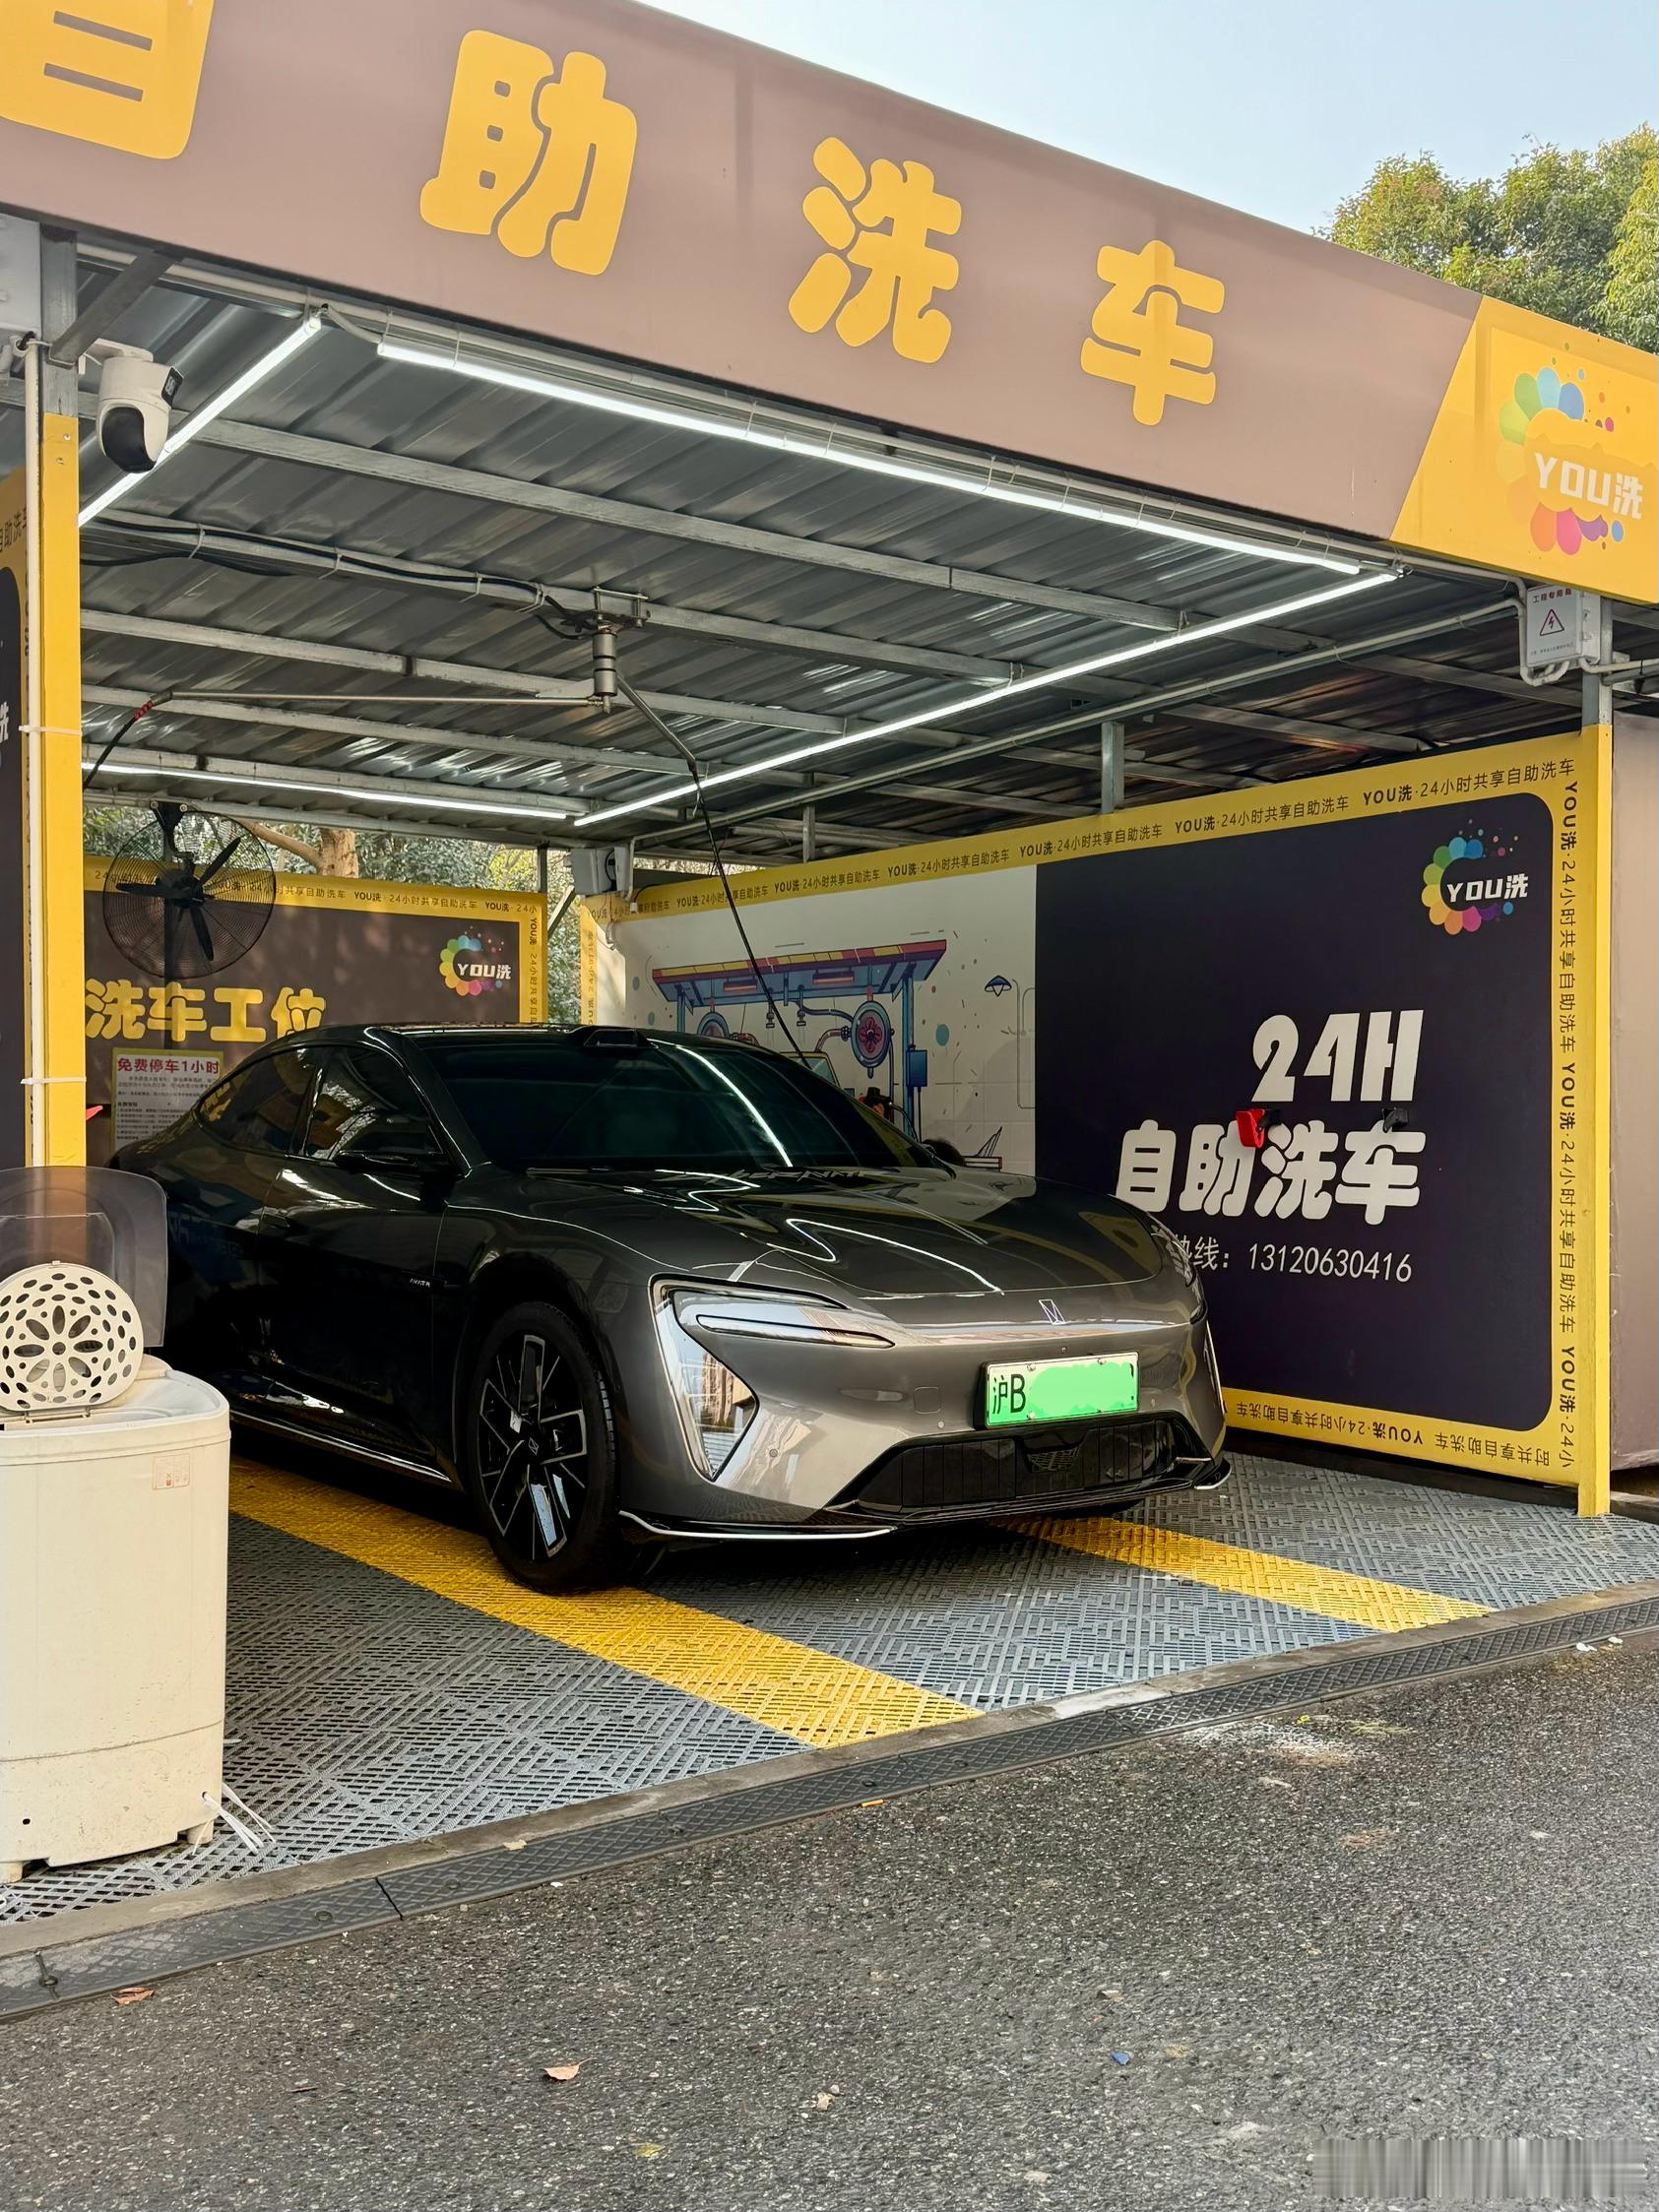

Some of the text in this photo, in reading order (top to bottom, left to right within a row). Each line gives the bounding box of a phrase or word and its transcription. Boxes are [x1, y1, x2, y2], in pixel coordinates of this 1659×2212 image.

[1534, 452, 1644, 520] YOU洗
[1446, 873, 1529, 903] YOU洗
[457, 963, 512, 980] YOU洗
[86, 978, 326, 1043] 洗车工位
[117, 1057, 220, 1074] 免费停车1小时
[1250, 1009, 1425, 1102] 24H
[1116, 1119, 1427, 1226] 自助洗车
